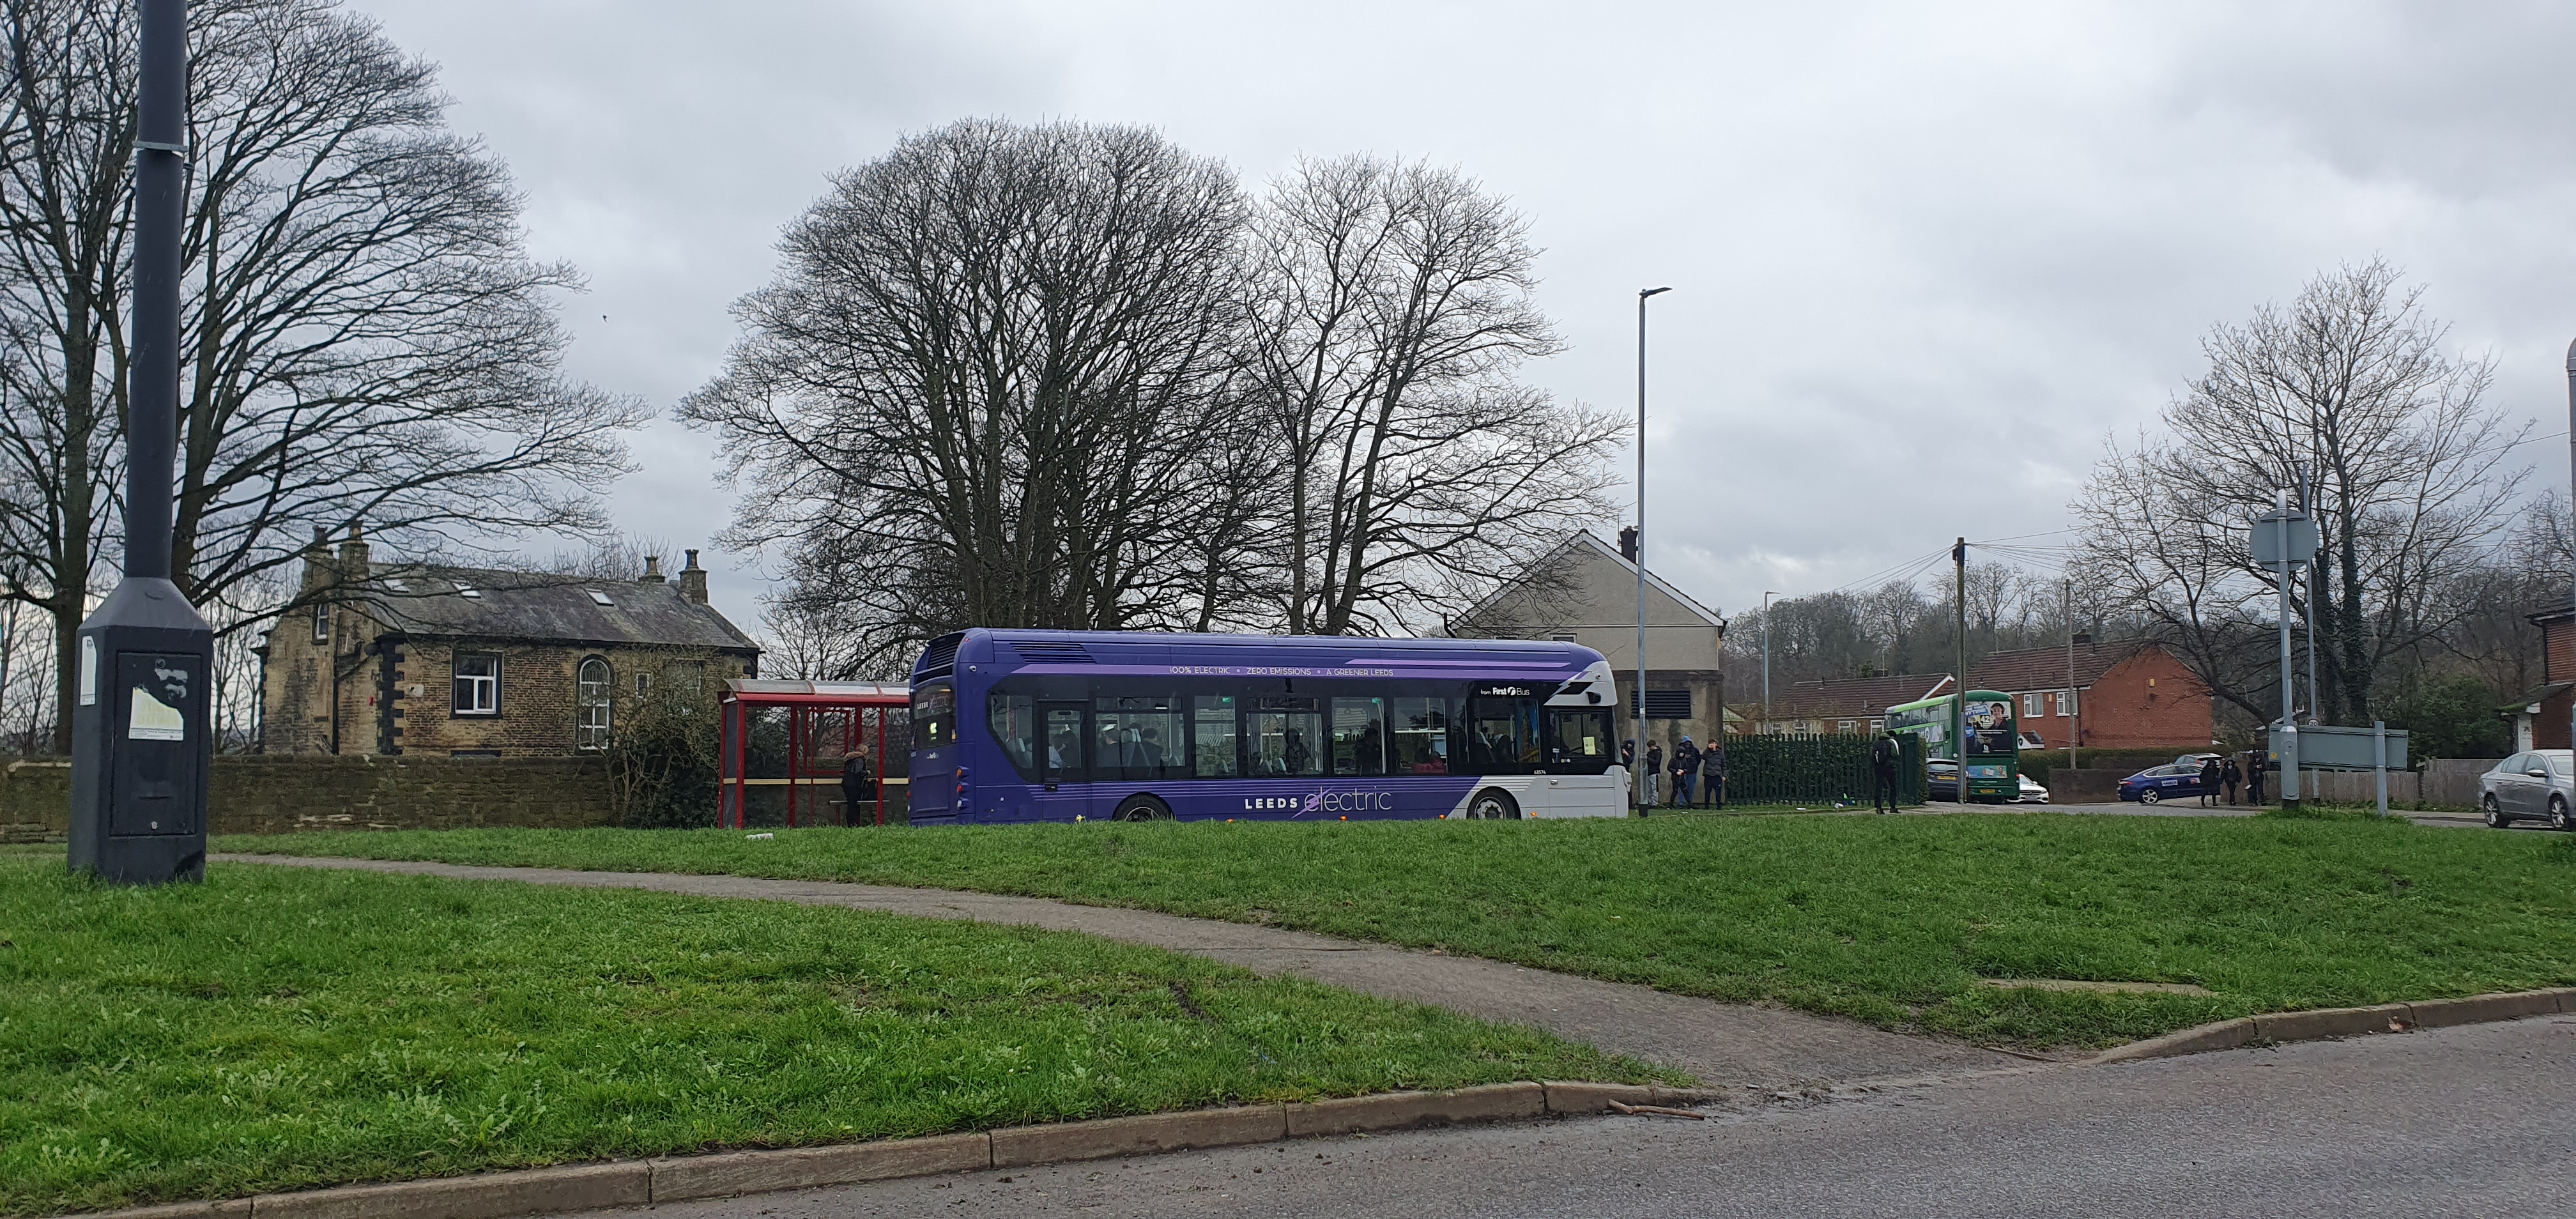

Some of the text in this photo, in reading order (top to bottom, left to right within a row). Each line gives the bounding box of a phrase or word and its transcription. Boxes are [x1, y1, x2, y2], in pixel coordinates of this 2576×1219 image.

[1492, 687, 1507, 695] First
[1517, 687, 1530, 696] Bus
[1245, 786, 1392, 811] LEEDS electric
